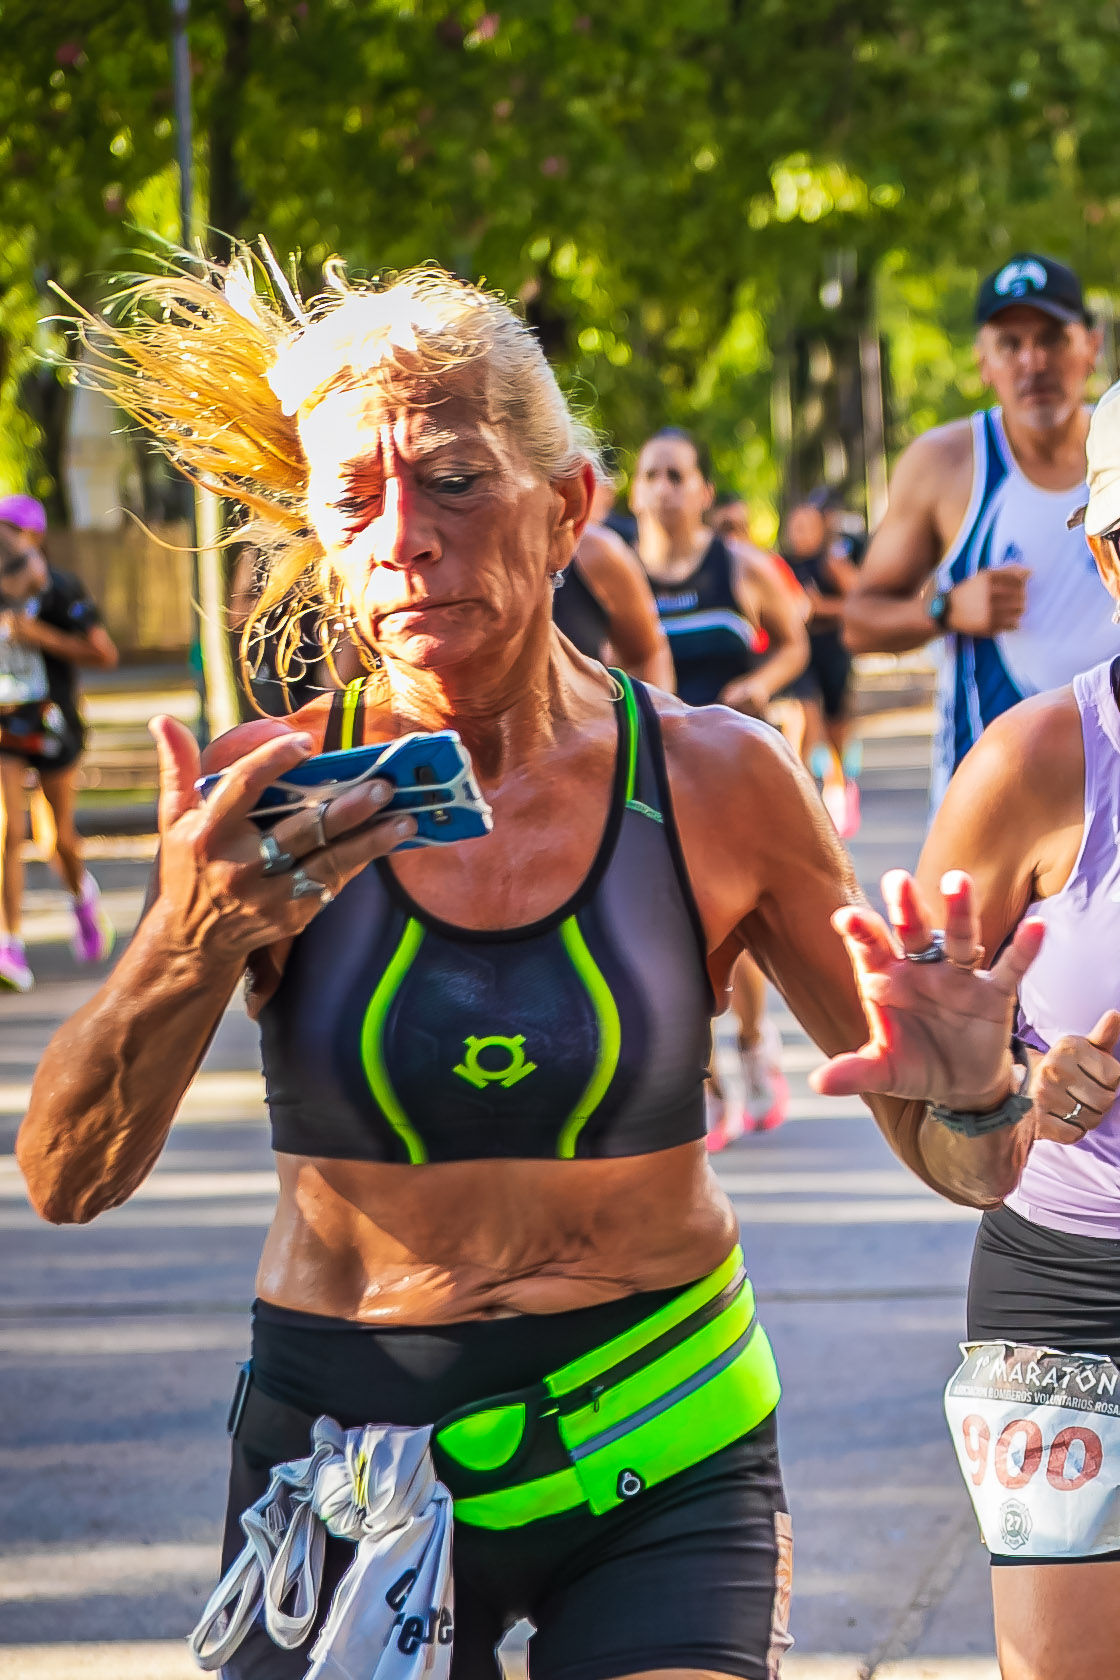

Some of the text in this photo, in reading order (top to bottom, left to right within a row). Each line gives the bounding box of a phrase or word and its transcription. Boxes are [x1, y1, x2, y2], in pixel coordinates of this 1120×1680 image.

[991, 1359, 1117, 1396] MARATÓN
[988, 1386, 1032, 1403] BOMBEROS
[1034, 1391, 1094, 1412] VOLUNTARIOS
[963, 1414, 1103, 1491] 900
